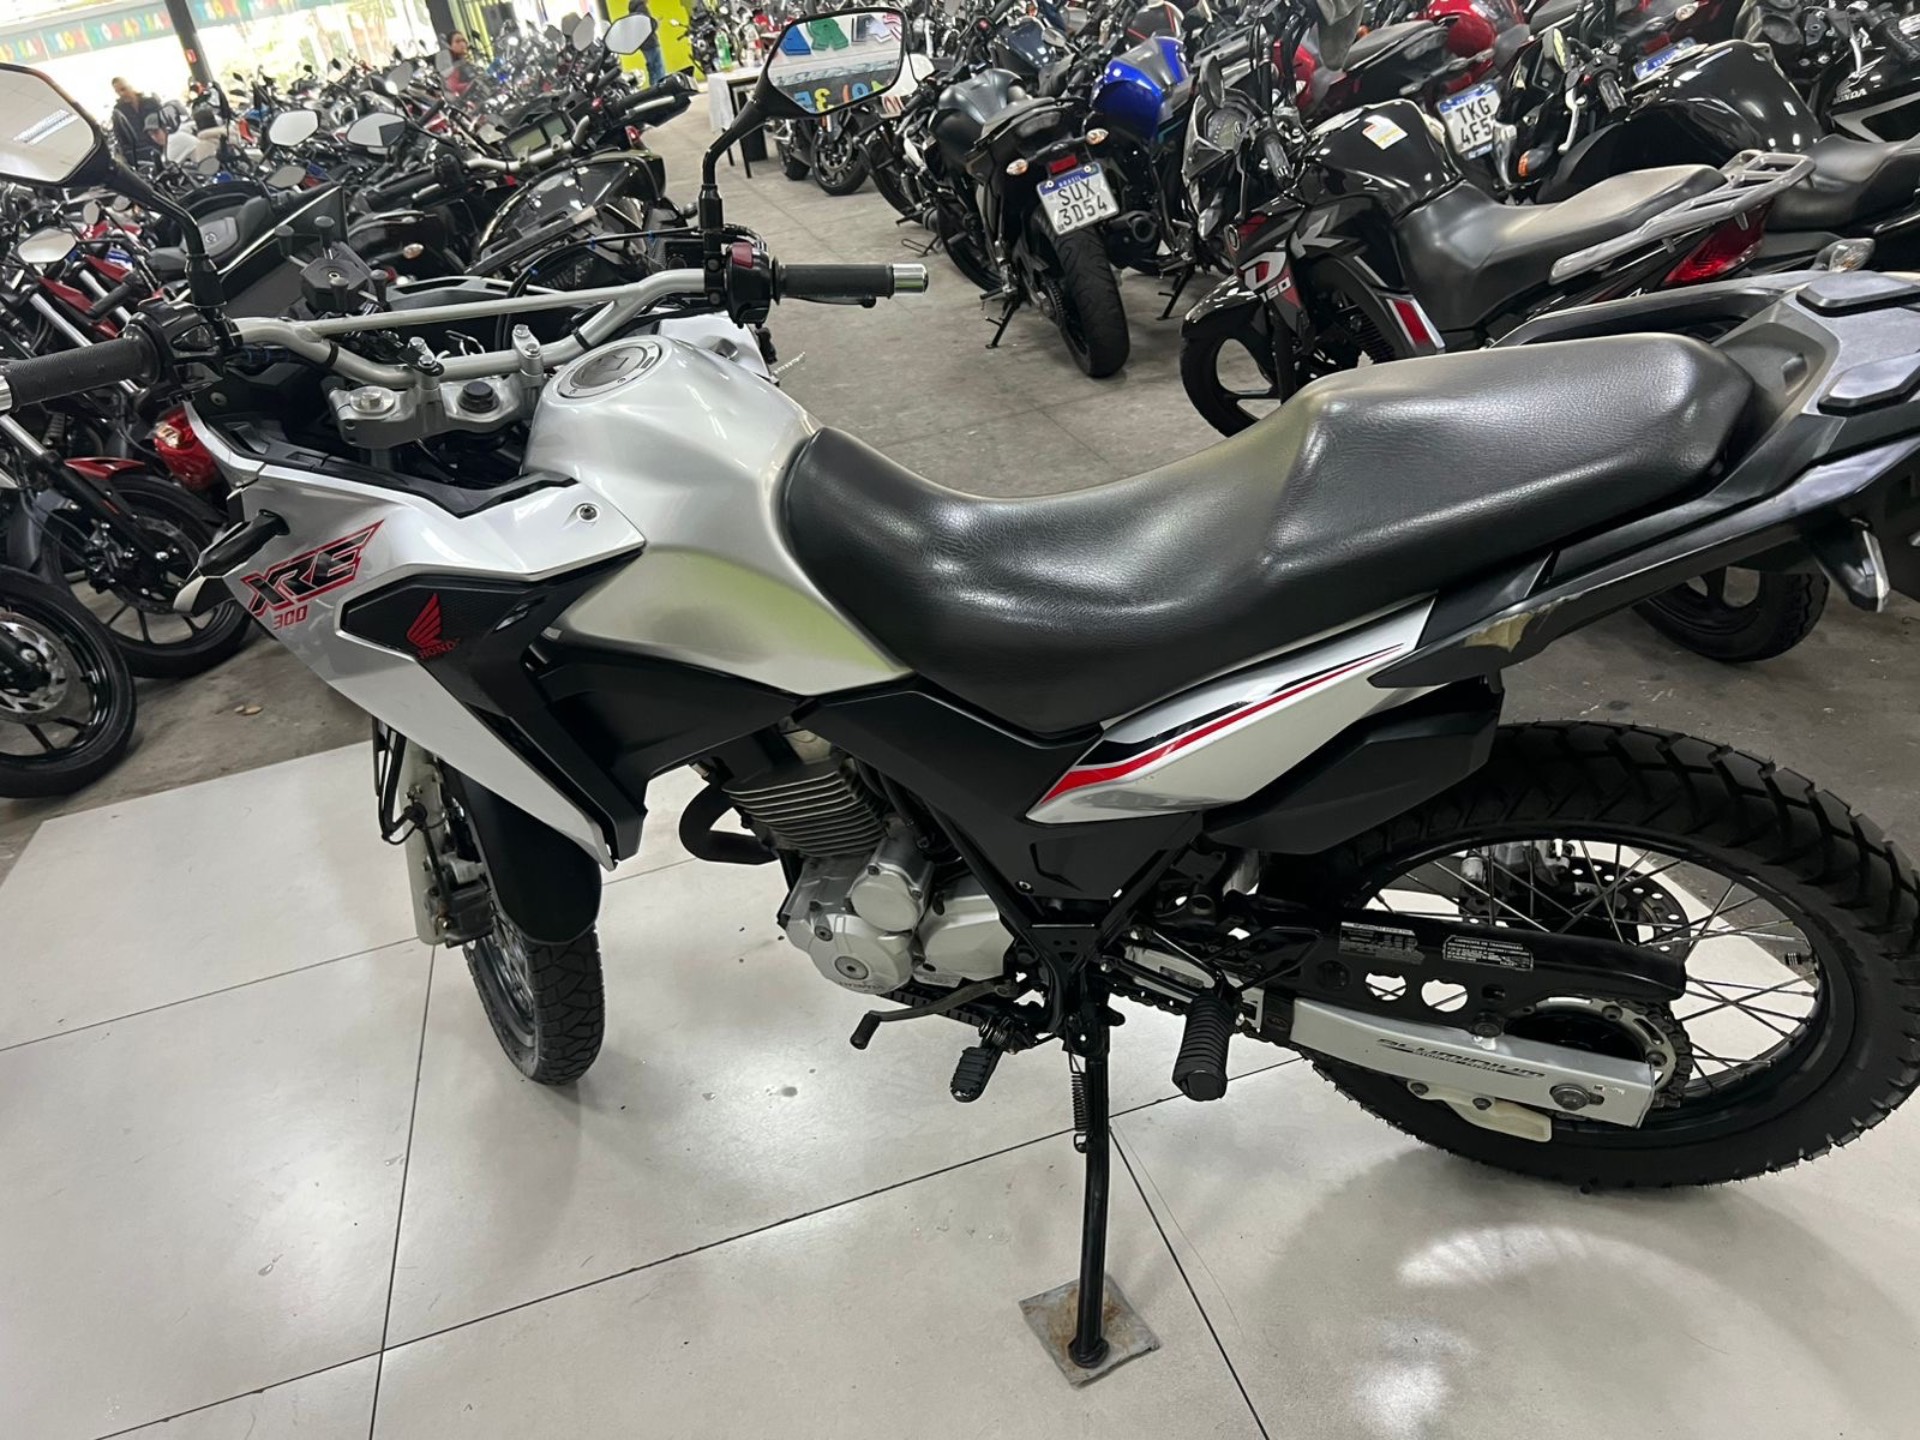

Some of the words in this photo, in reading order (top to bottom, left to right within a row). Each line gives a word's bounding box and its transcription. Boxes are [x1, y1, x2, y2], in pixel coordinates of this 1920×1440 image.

[1455, 97, 1491, 125] TKG
[1831, 88, 1868, 106] HONDA
[1460, 114, 1496, 145] 4F5
[1057, 178, 1096, 206] SUX
[1058, 194, 1108, 226] 3D54
[1258, 276, 1292, 303] 160
[240, 518, 385, 618] XRE
[273, 604, 308, 630] 300
